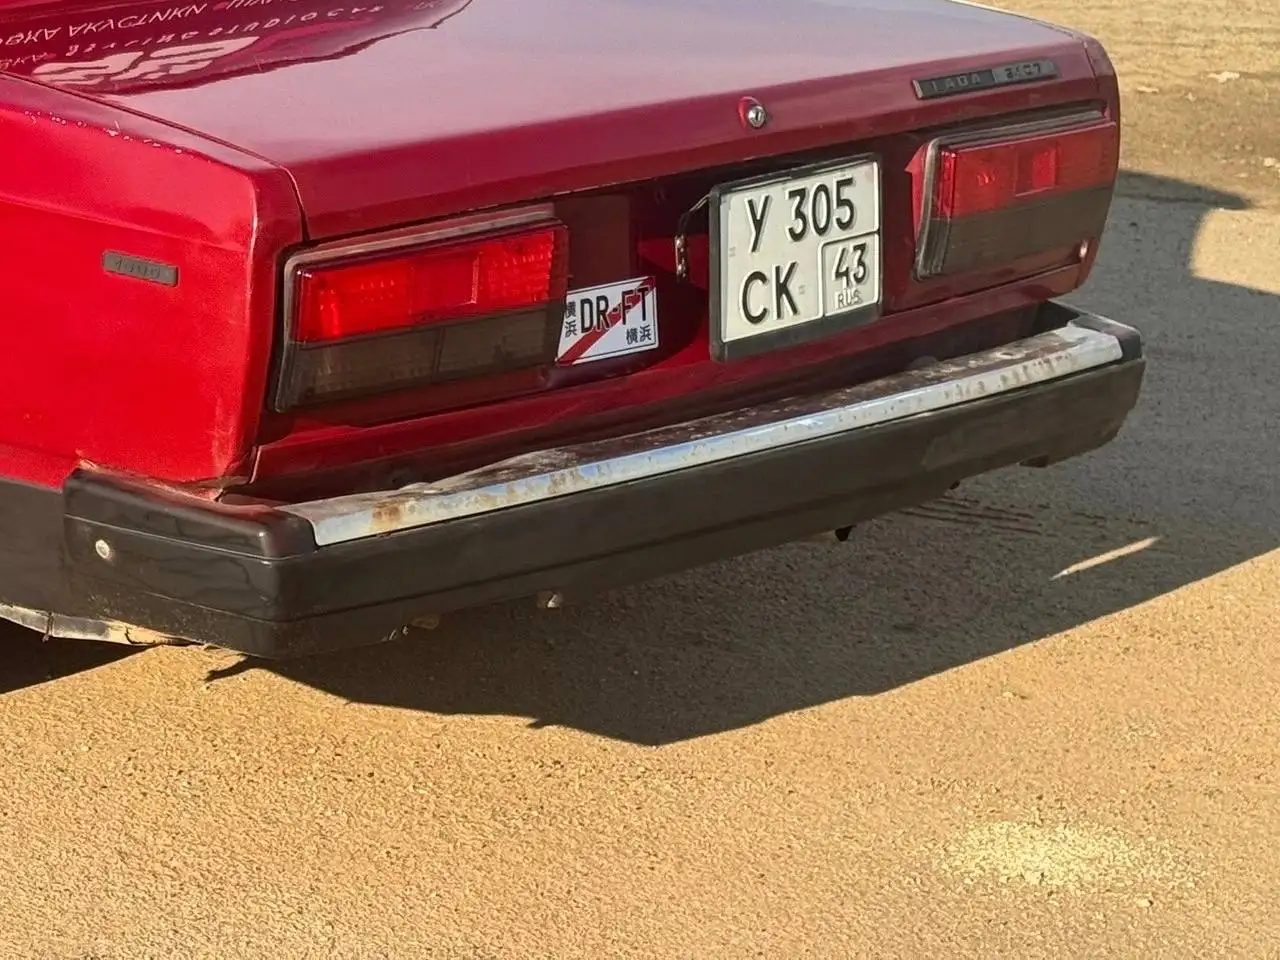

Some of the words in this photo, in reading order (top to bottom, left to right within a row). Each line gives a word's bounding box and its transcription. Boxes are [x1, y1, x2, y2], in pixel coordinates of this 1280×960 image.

[787, 177, 855, 242] 305
[833, 242, 867, 288] 43
[836, 289, 863, 309] RUS
